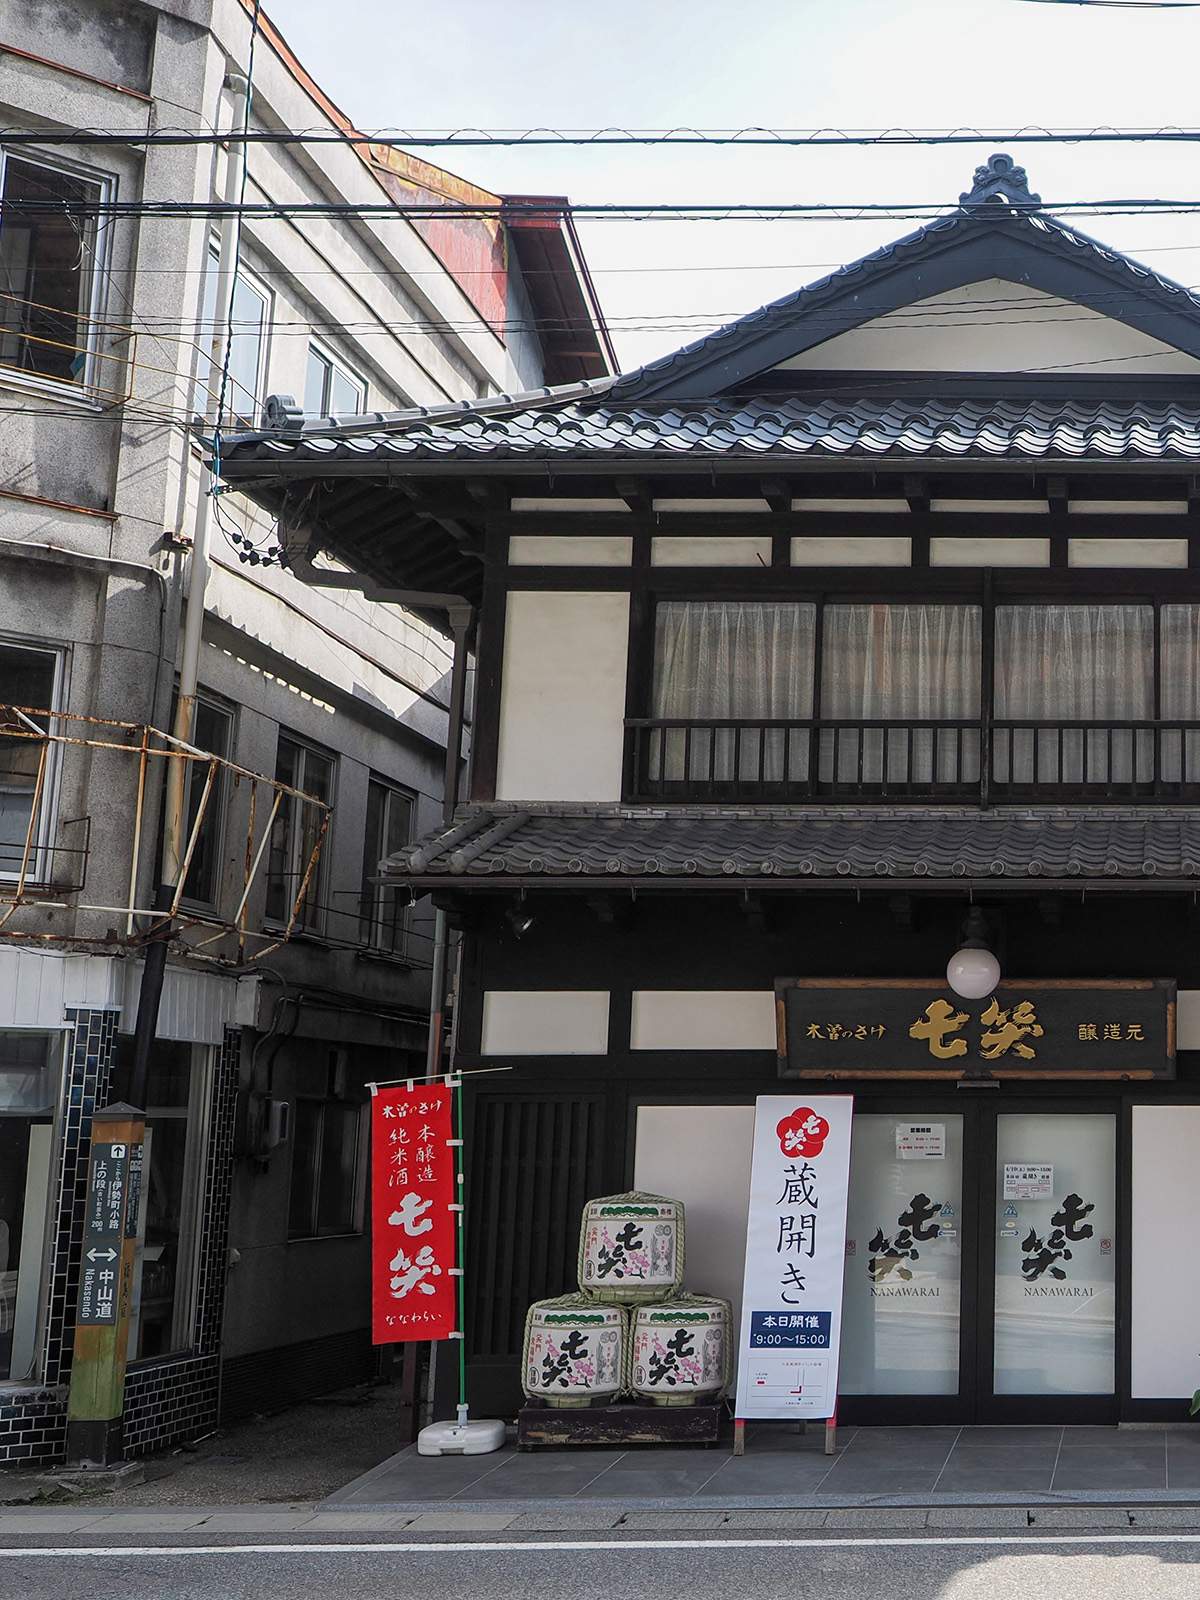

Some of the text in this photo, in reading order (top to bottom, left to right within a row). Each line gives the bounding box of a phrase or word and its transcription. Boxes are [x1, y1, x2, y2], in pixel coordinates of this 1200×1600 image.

[1077, 1023, 1146, 1041] 醸造元
[388, 1127, 411, 1187] 純米酒
[415, 1123, 438, 1183] 本醸造
[776, 1161, 819, 1304] 蔵開き
[82, 1268, 95, 1318] Nakasendo
[95, 1269, 114, 1318] 中山道
[870, 1287, 940, 1297] NANAWARAI
[1024, 1287, 1094, 1297] NANAWARAI
[385, 1312, 442, 1326] ななわらい
[762, 1315, 820, 1328] 本日開催
